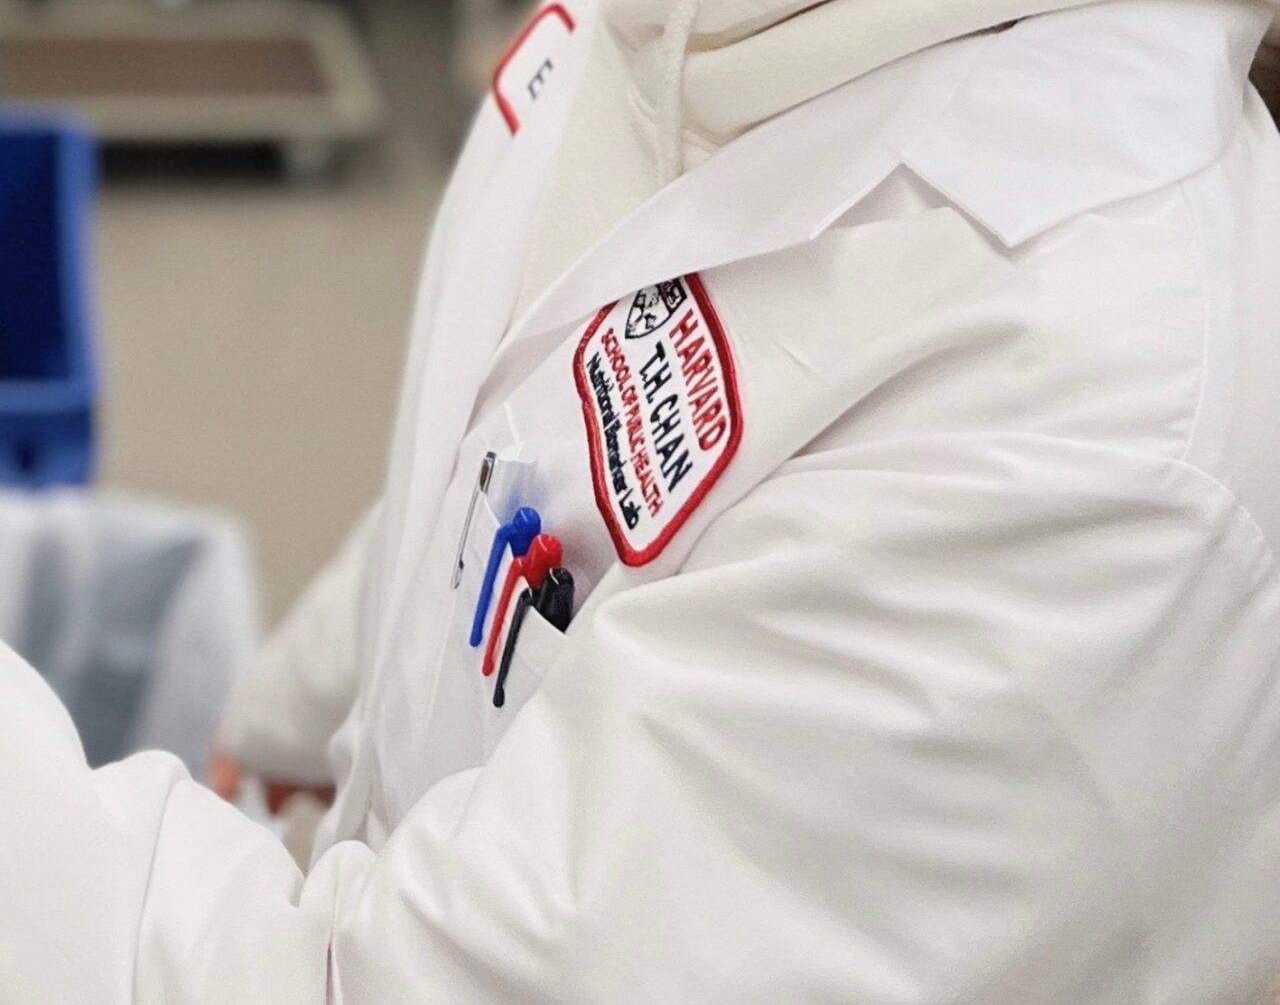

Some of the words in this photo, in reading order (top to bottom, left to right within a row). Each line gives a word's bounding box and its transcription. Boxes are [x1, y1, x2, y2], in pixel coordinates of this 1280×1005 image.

[601, 327, 632, 391] SCHOOL
[621, 385, 639, 407] OF
[631, 452, 664, 517] HEALTH
[639, 341, 672, 404] T.H.
[669, 308, 728, 452] HARVARD
[650, 394, 694, 493] CHAN
[619, 490, 642, 530] Lab
